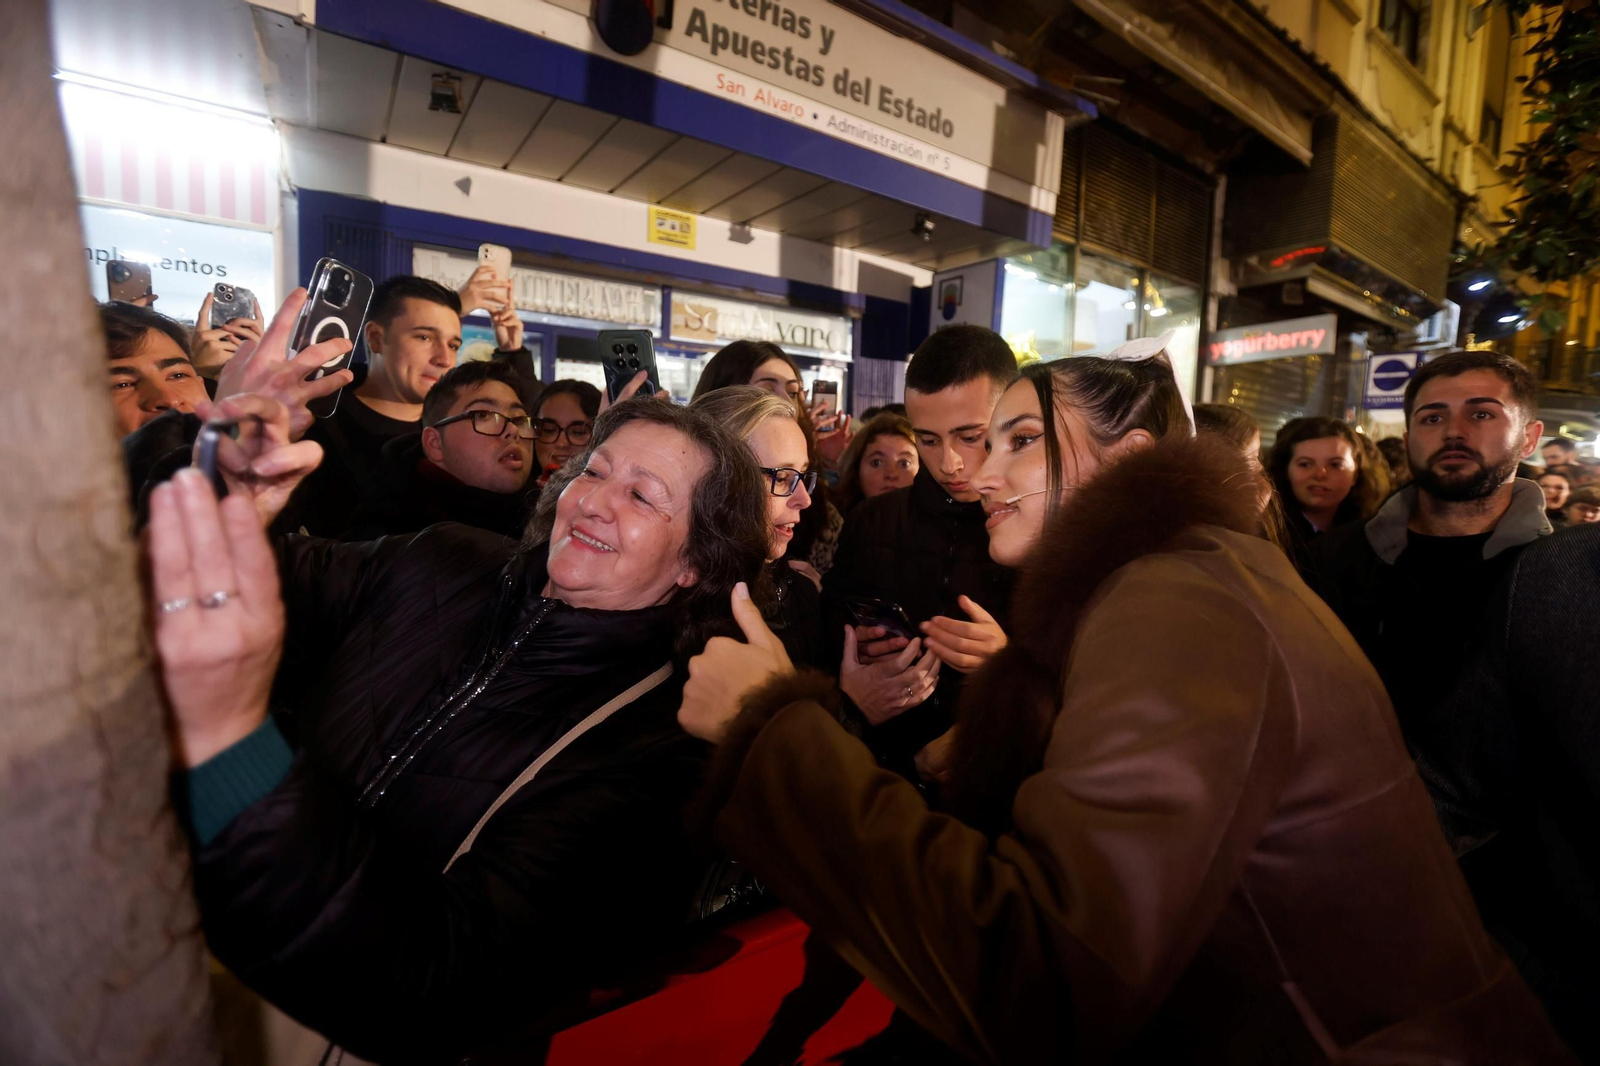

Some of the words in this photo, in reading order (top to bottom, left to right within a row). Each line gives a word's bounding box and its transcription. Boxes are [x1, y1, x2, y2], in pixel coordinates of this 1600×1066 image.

[685, 7, 825, 87] Apuestas
[833, 67, 871, 106] del
[877, 84, 955, 139] Estado
[819, 24, 835, 56] y
[716, 73, 745, 97] San
[754, 87, 804, 119] Alvaro
[827, 114, 922, 160] Administración
[944, 157, 951, 170] 5
